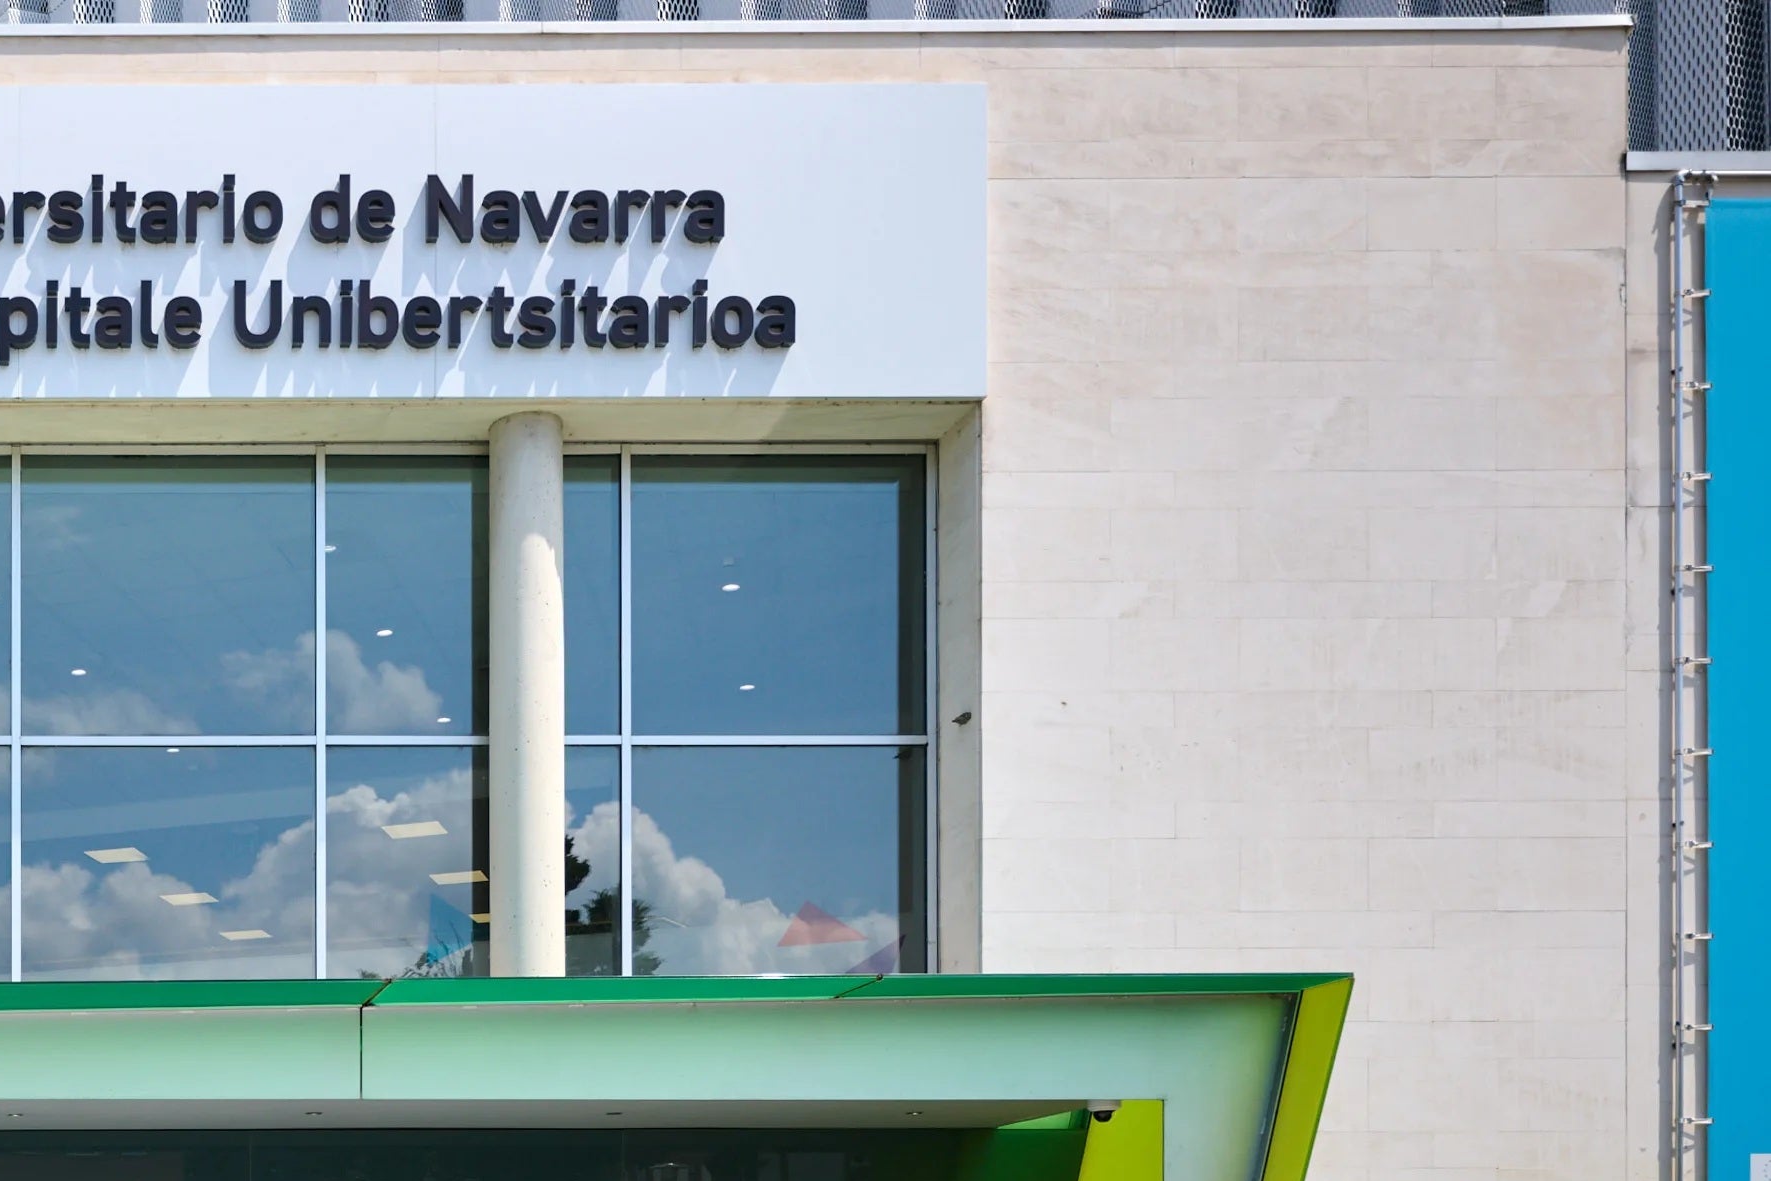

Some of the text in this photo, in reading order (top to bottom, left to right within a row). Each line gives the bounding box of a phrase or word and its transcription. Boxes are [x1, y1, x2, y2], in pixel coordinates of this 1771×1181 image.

[309, 174, 396, 245] de
[425, 174, 725, 247] Navarra
[233, 279, 796, 352] Unibertsitarioa
